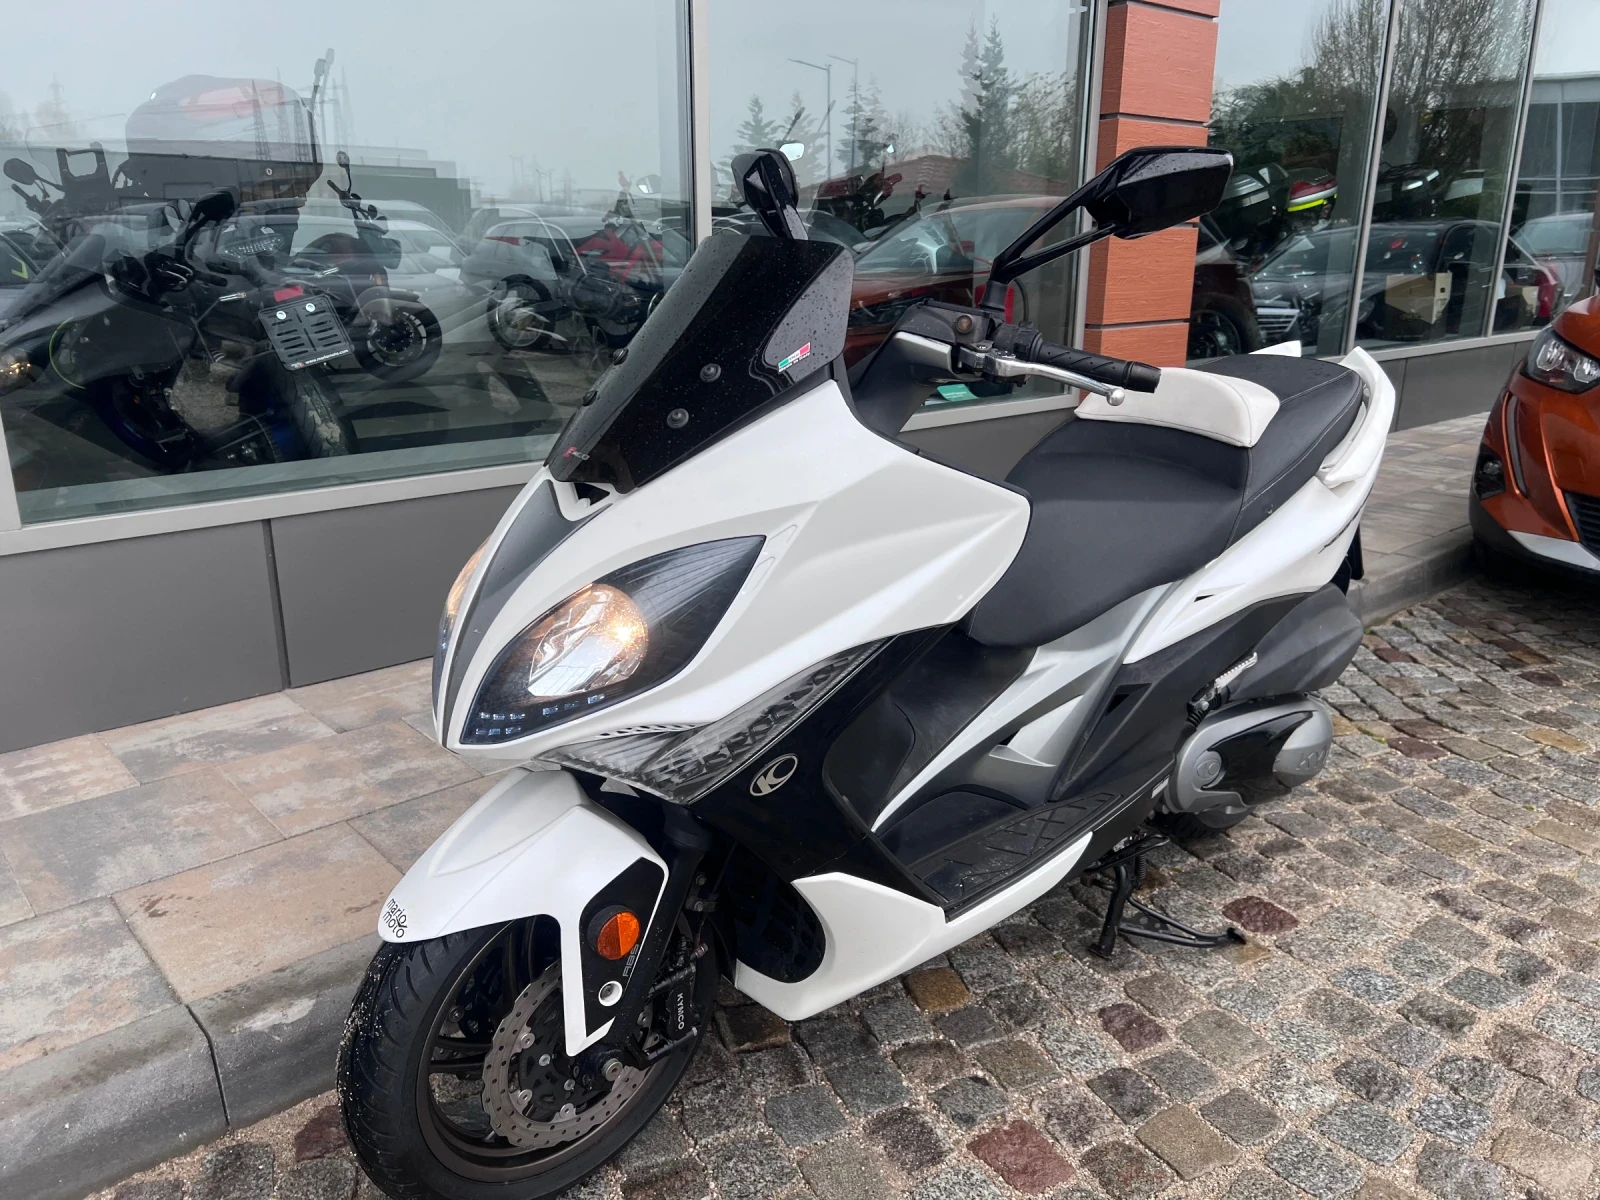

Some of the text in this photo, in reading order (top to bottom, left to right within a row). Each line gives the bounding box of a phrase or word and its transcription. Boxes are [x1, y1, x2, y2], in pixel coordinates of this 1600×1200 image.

[382, 911, 405, 938] moto
[386, 898, 407, 924] mario
[676, 992, 685, 1030] KYMCO
